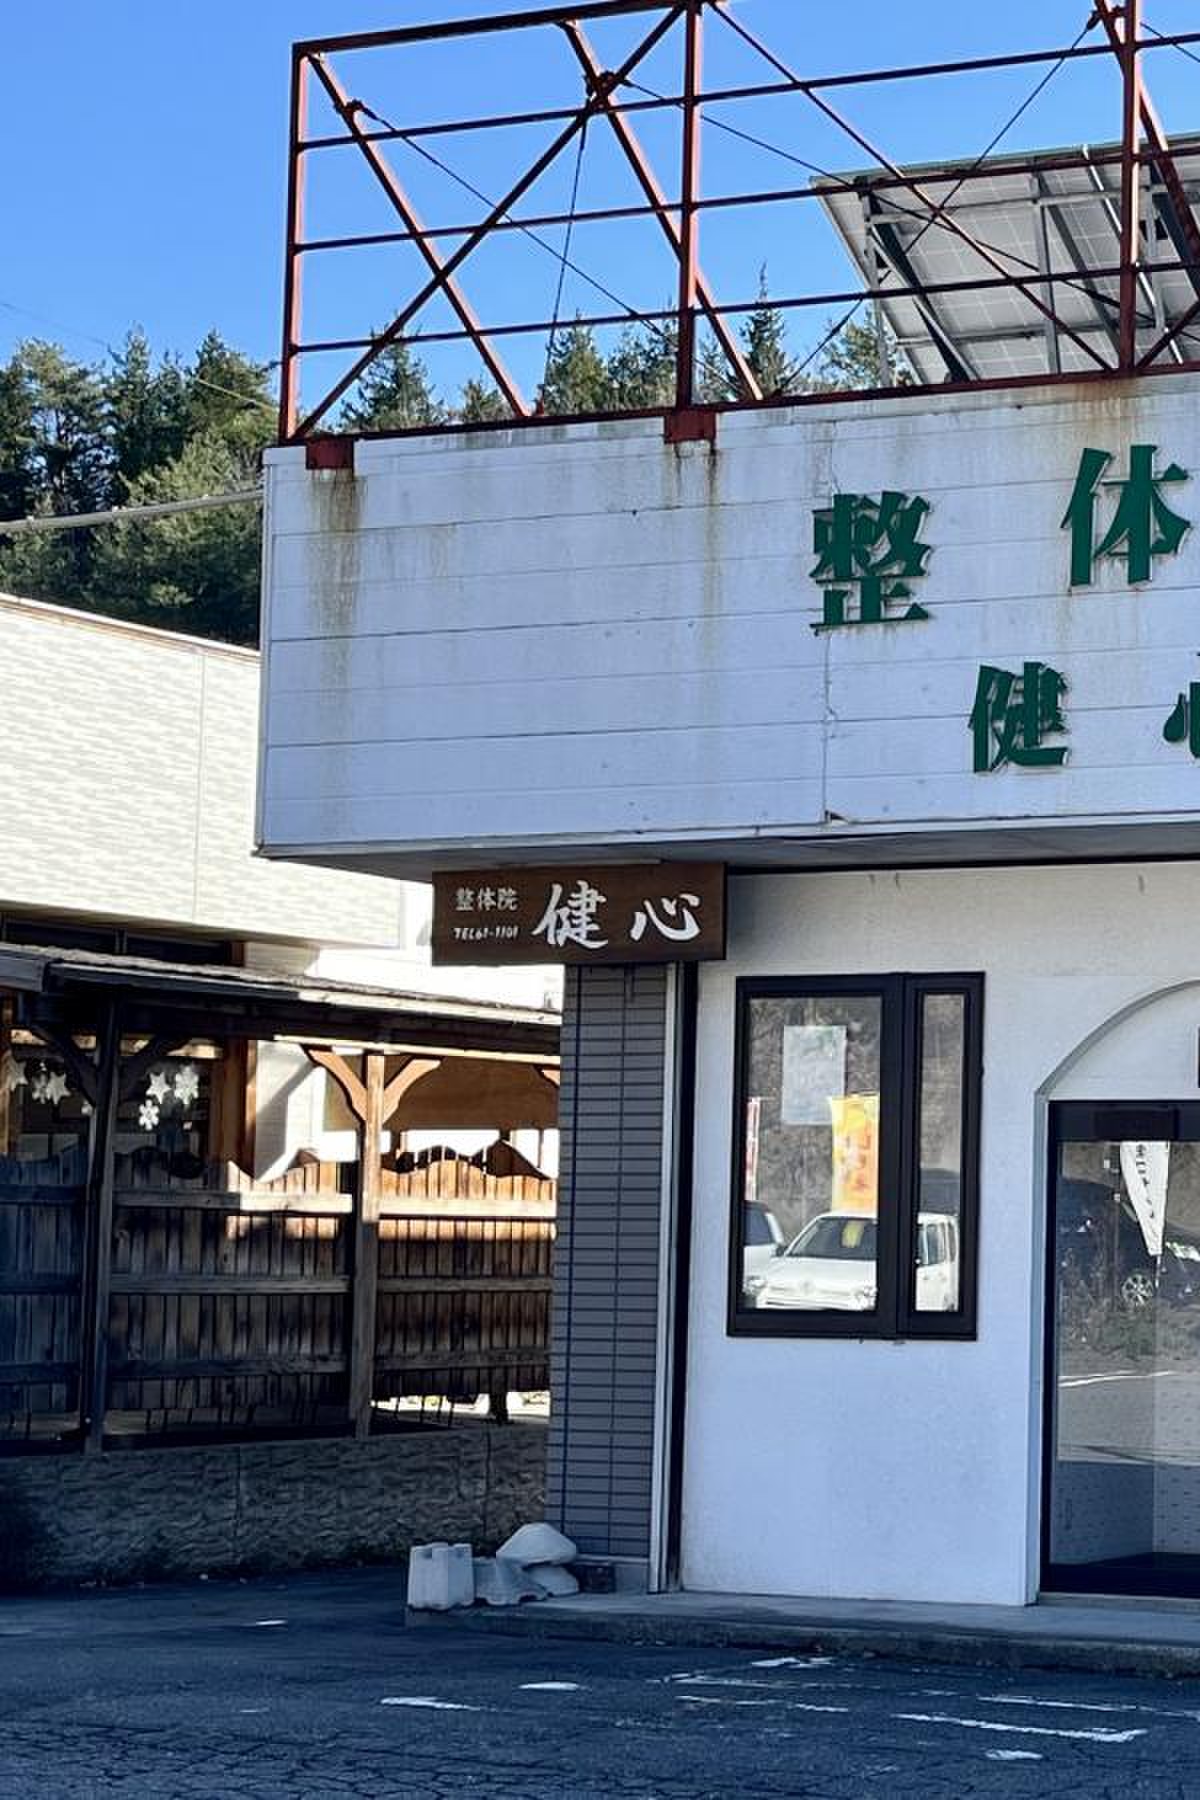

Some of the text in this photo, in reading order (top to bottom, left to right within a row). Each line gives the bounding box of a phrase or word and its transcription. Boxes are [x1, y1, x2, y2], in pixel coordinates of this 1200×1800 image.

[455, 887, 518, 911] 整体院
[531, 880, 701, 949] 健心
